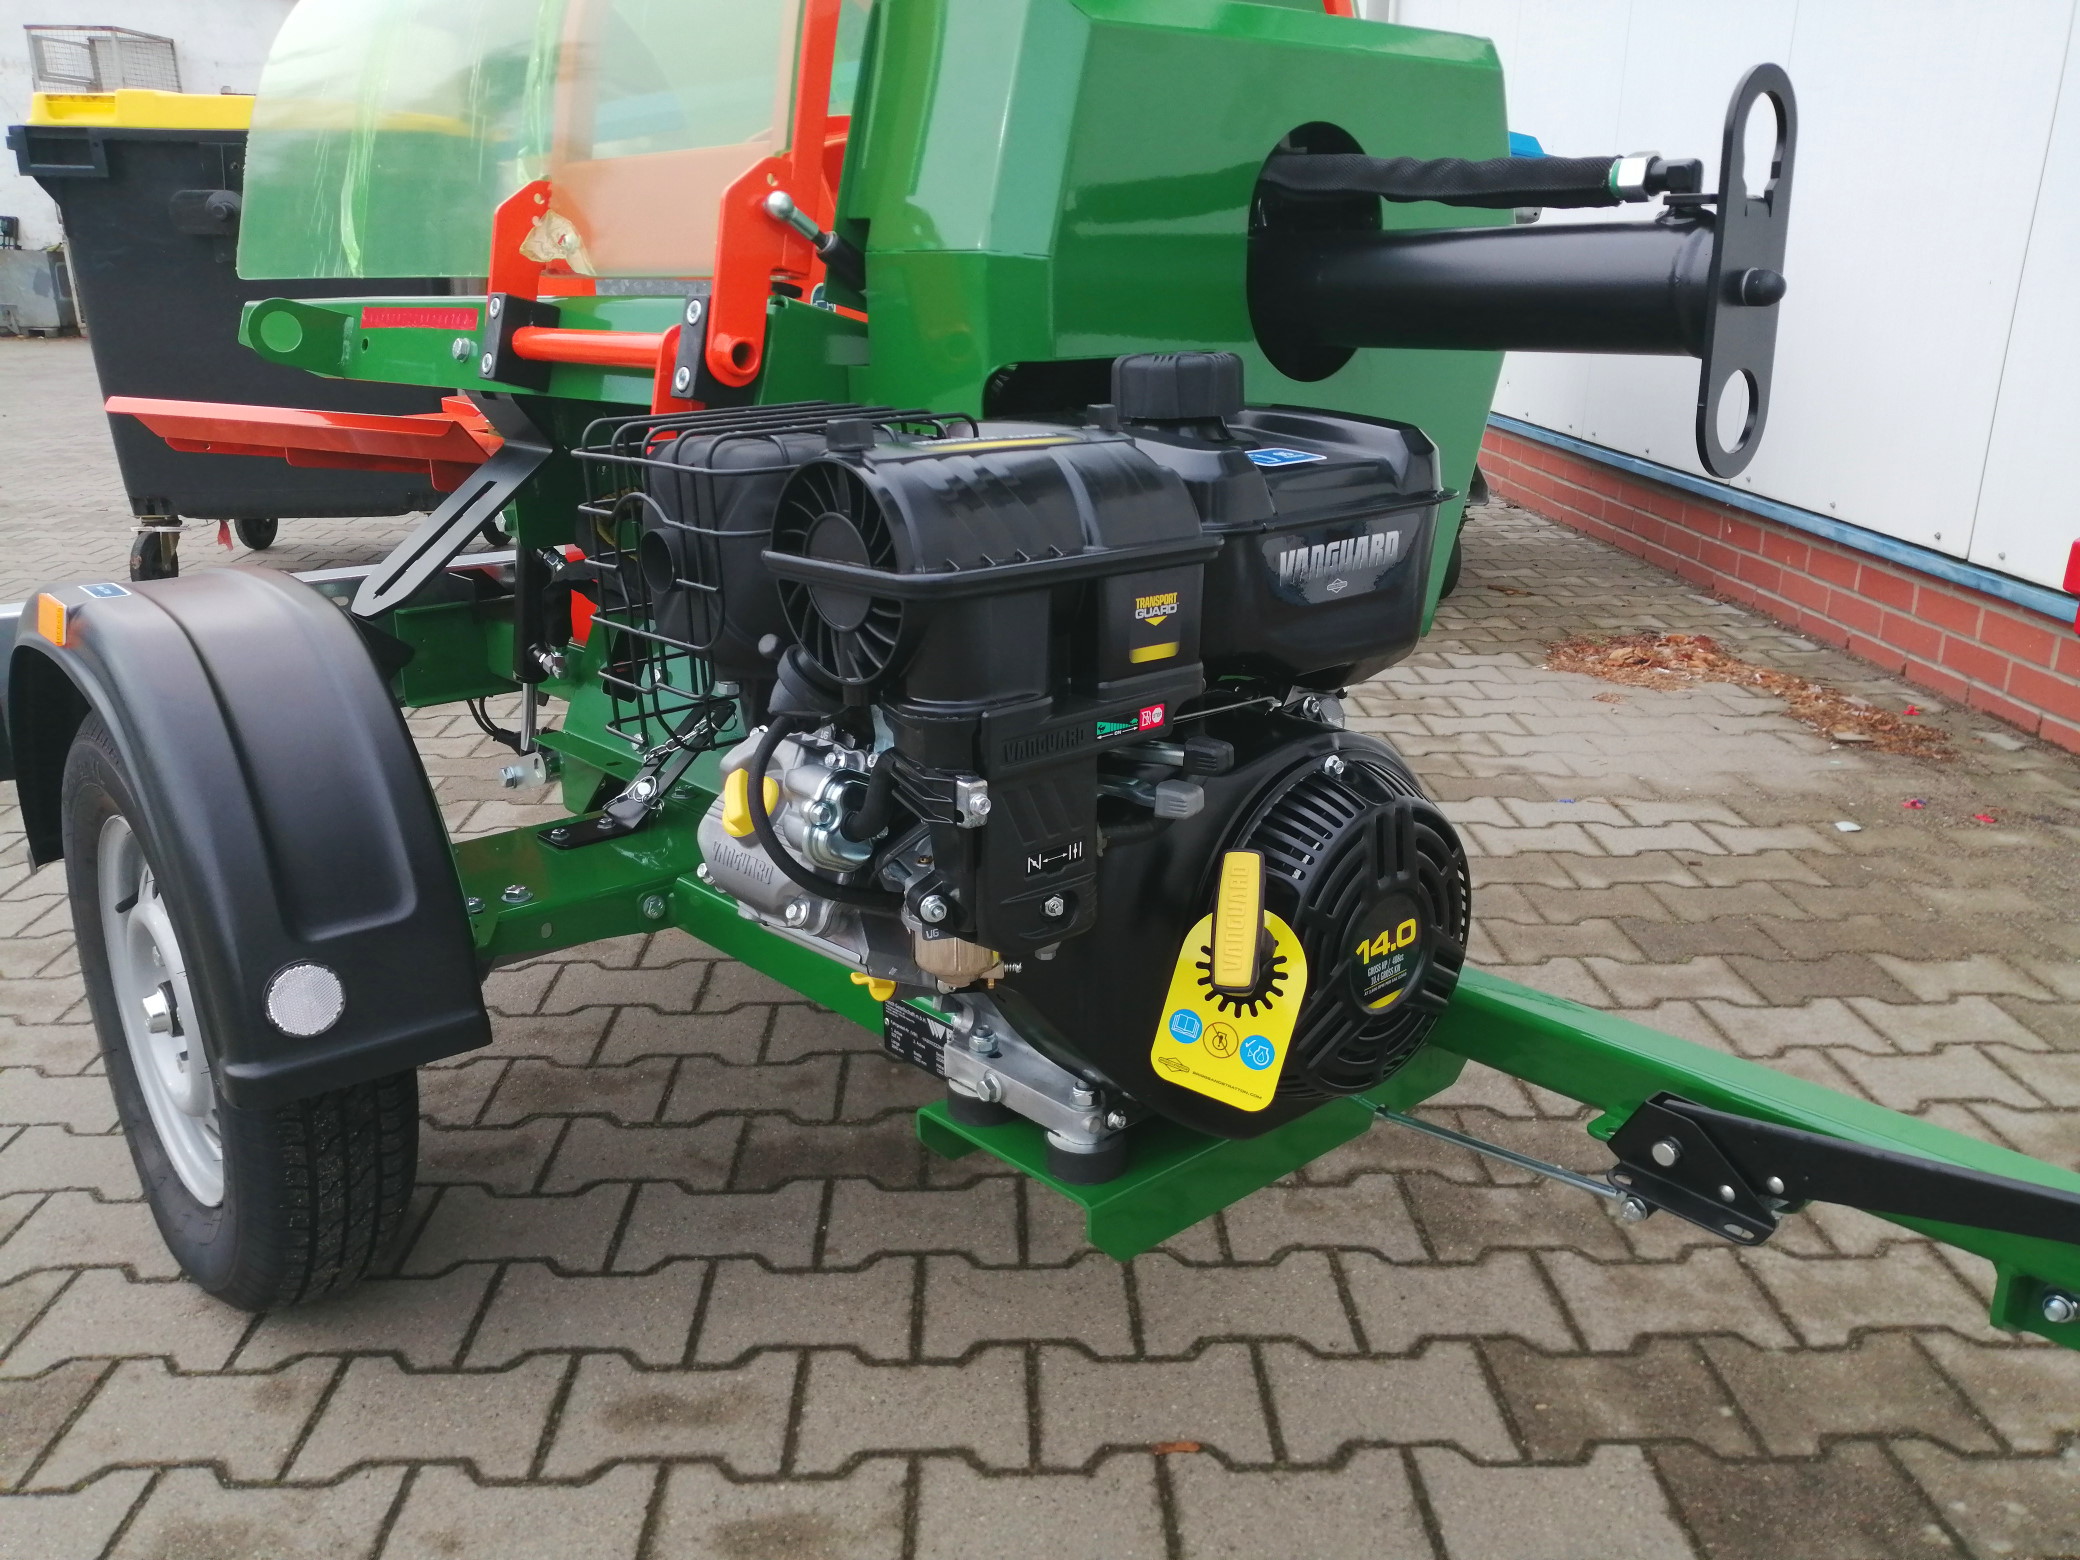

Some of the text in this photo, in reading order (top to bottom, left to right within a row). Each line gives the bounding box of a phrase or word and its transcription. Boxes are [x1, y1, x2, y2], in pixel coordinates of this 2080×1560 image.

[1280, 530, 1400, 587] VANGUARD
[1135, 592, 1178, 609] TRANSPORT
[1135, 603, 1178, 619] GUARD
[1152, 711, 1162, 719] STOP
[1003, 727, 1084, 763] VANGUARD
[713, 840, 775, 885] VANGUARD
[1223, 867, 1248, 971] VANGUARD
[1355, 918, 1416, 964] 14.0
[1368, 961, 1382, 977] GROSS
[1380, 966, 1394, 980] GROSS
[1192, 1071, 1263, 1100] BRIGGSANDSTRATTON.COM
